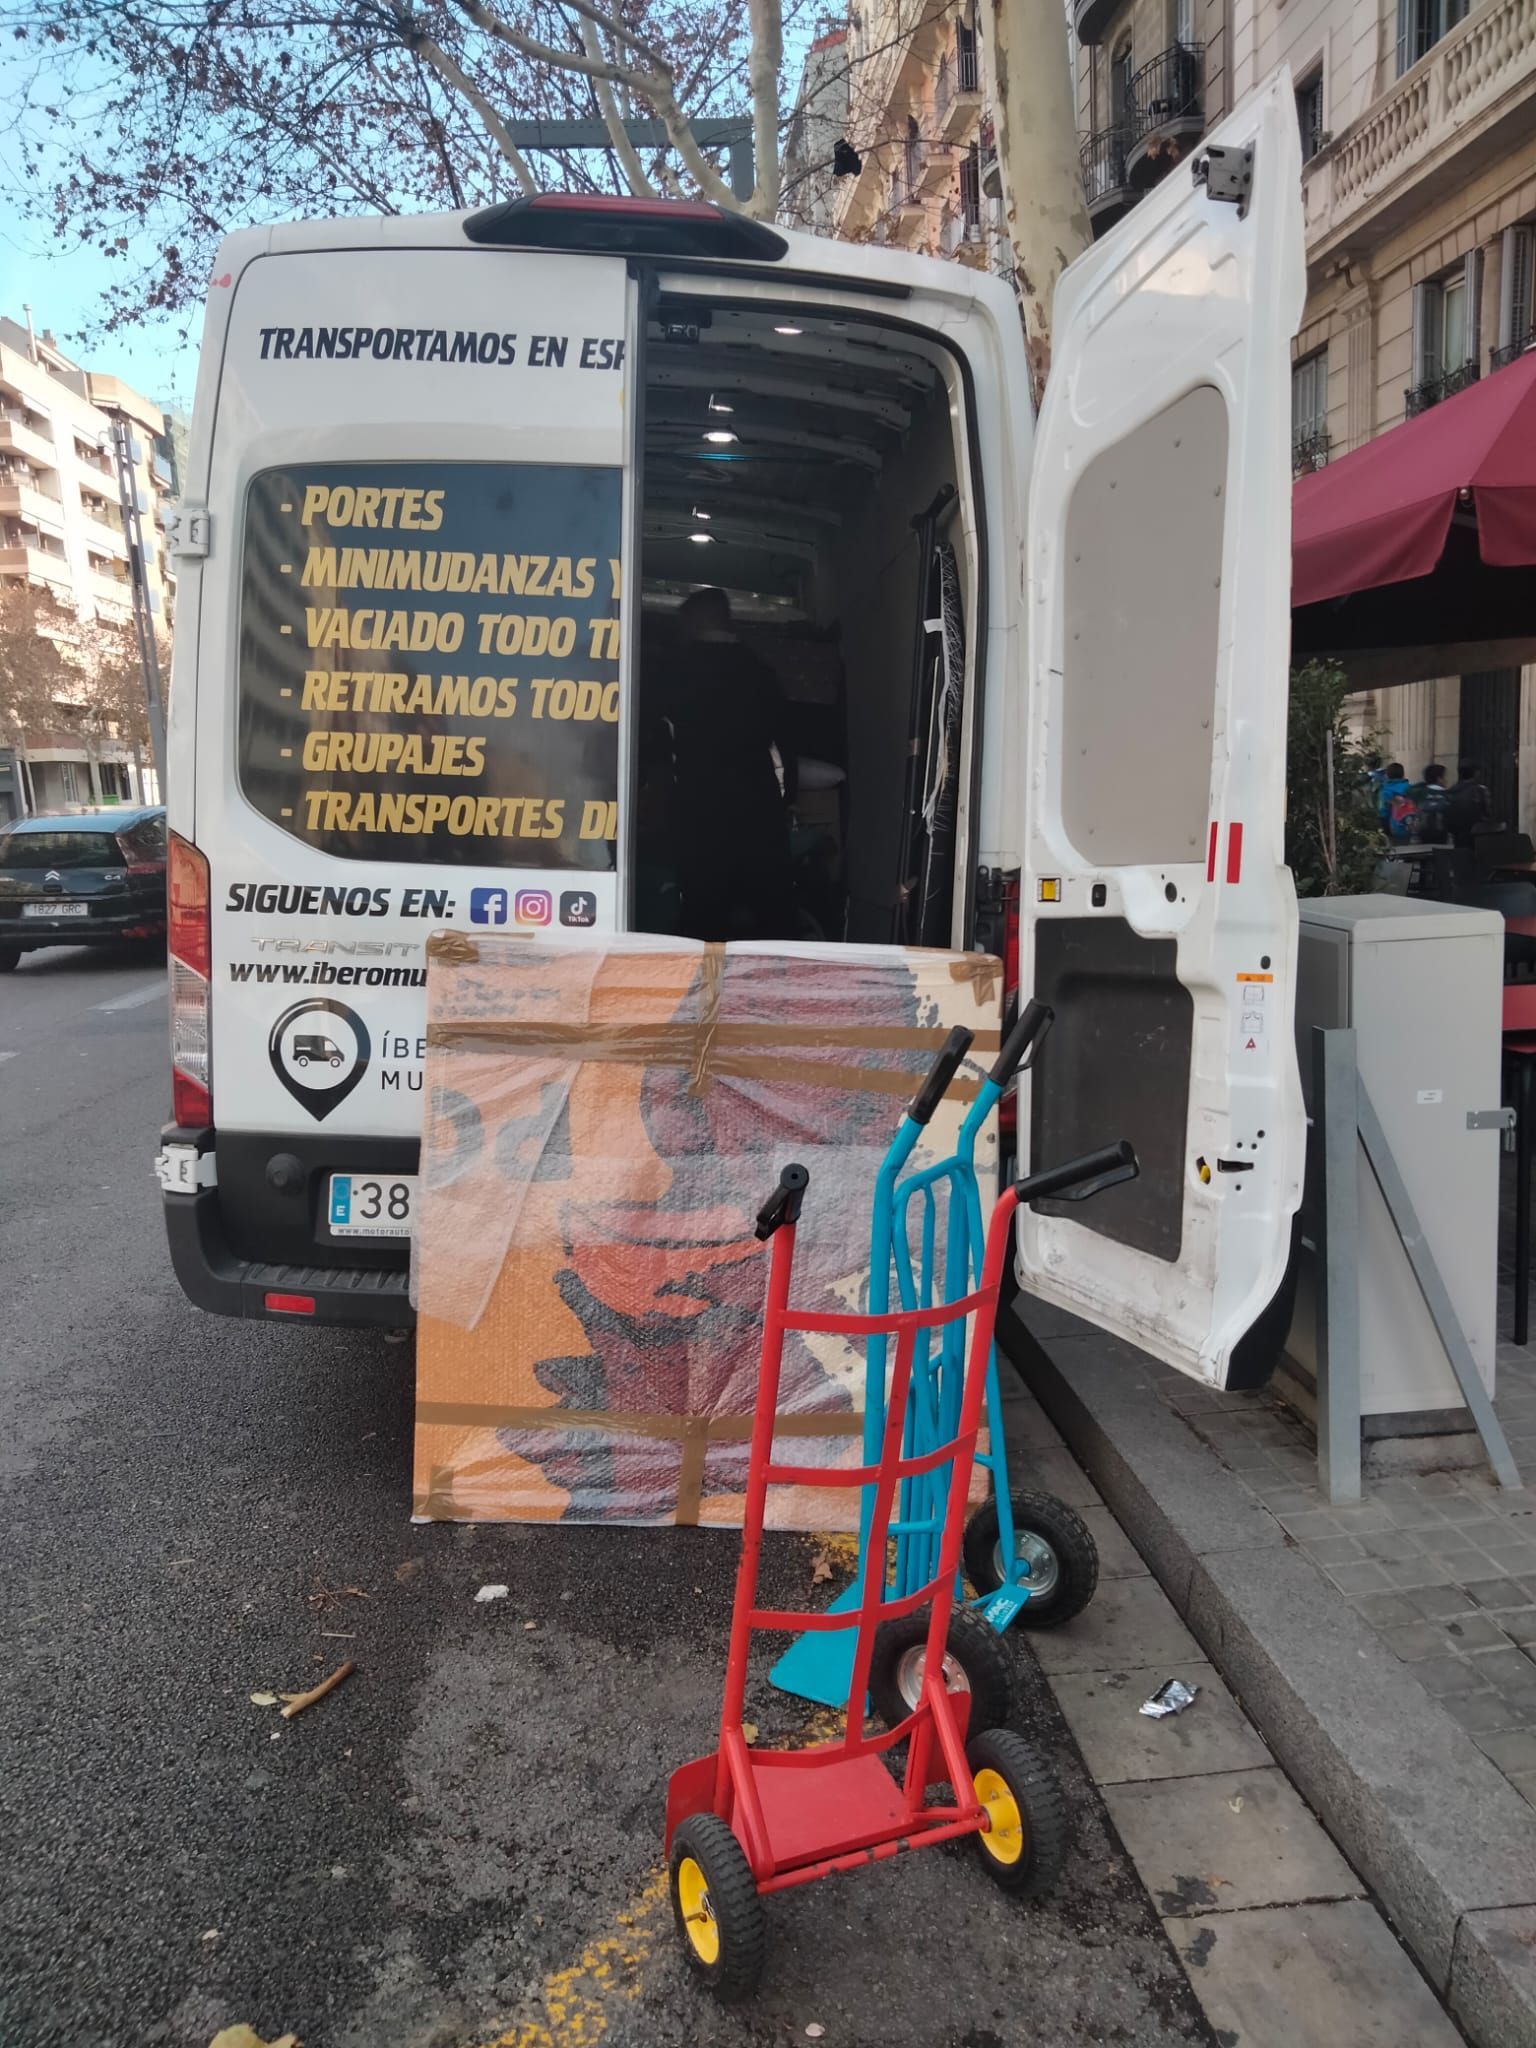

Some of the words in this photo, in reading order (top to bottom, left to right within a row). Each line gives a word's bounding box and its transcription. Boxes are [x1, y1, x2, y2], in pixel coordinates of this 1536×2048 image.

[259, 327, 516, 365] TRANSPORTAMOS
[527, 335, 569, 367] EN
[301, 485, 445, 530] PORTES
[301, 547, 595, 597] MINIMUDANZAS
[304, 607, 464, 652] VACIADO
[477, 613, 577, 657] TODO
[301, 671, 517, 718] RETIRAMOS
[302, 731, 486, 777] GRUPAJES
[305, 791, 565, 839] TRANSPORTES
[225, 883, 391, 917] SIGUENOS
[400, 888, 456, 919] EN:
[252, 937, 420, 957] TRANSIT
[229, 962, 427, 987] www.iberomu
[381, 1070, 424, 1091] MU
[336, 1205, 346, 1217] E
[360, 1182, 410, 1220] 38
